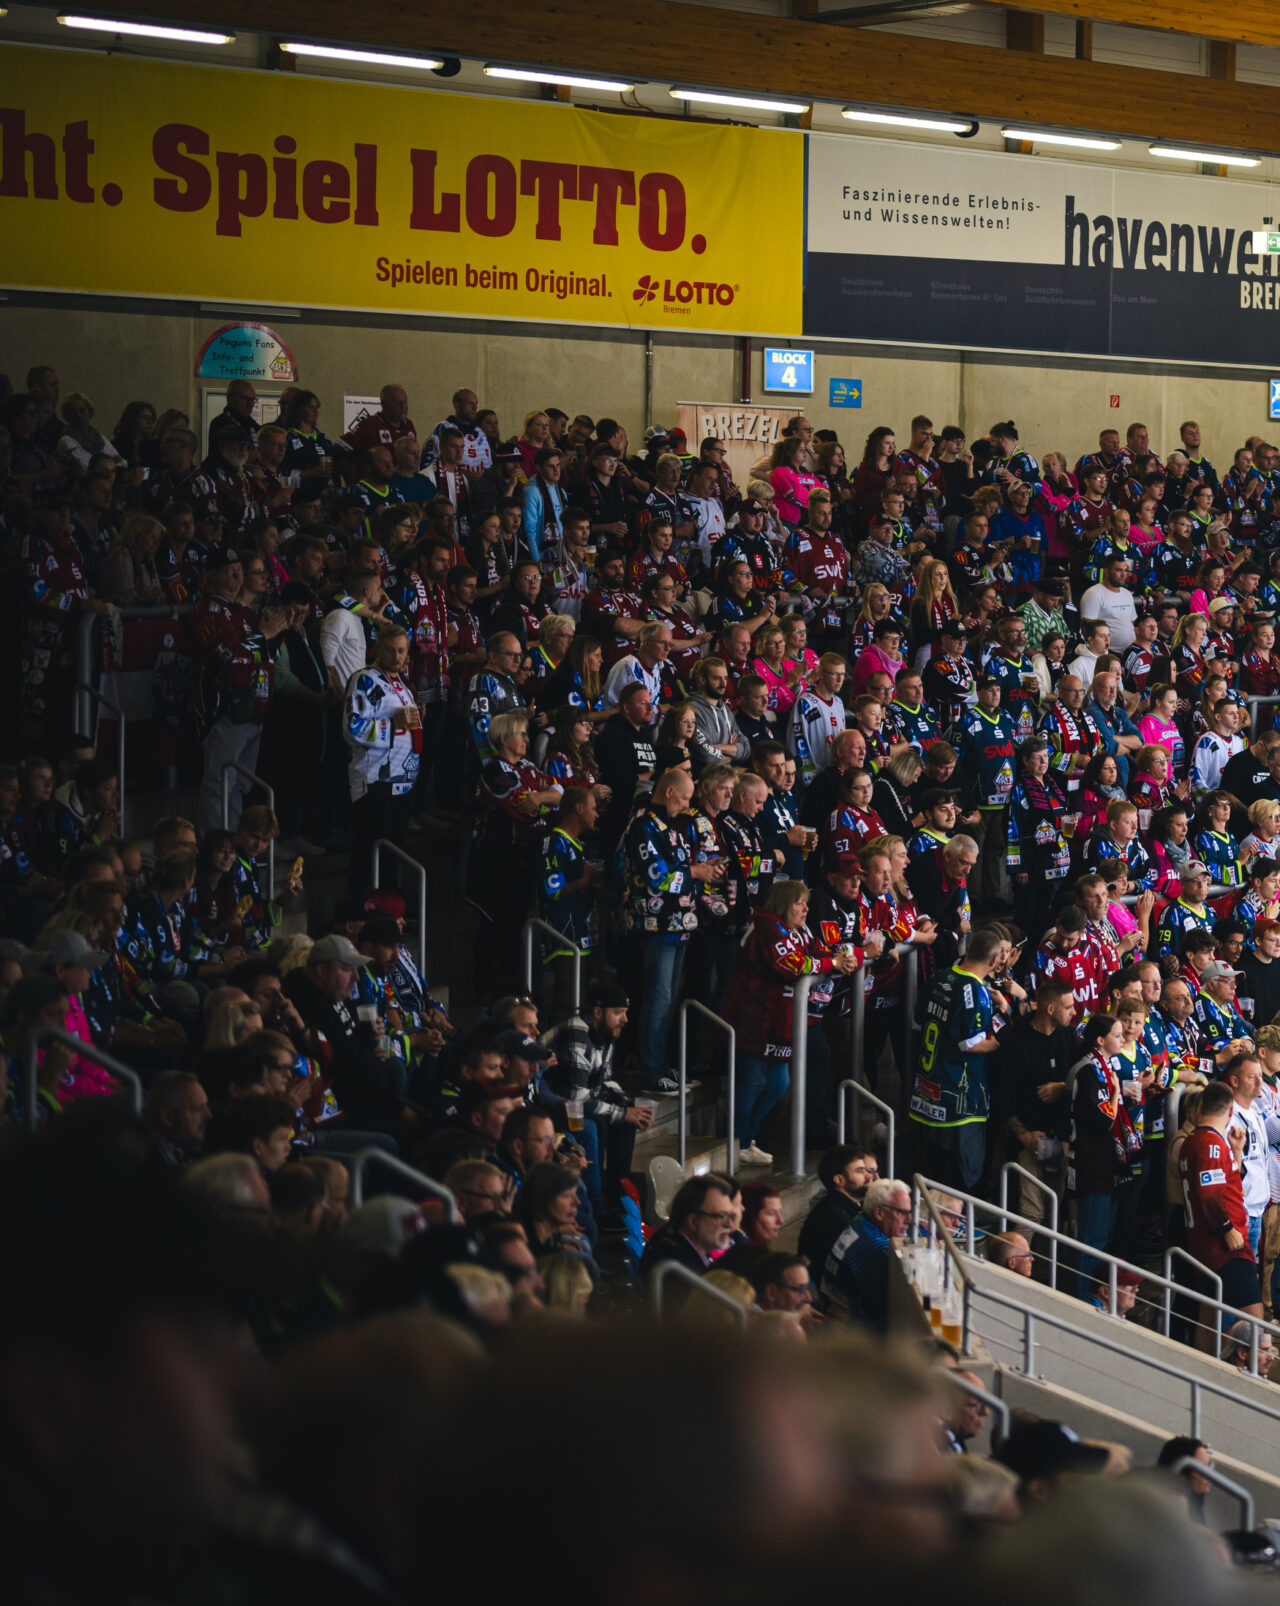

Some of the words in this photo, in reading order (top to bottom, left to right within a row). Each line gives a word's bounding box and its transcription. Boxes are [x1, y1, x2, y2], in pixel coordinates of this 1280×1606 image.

[152, 122, 380, 237] Spiel
[409, 147, 708, 254] LOTTO.
[842, 185, 960, 208] Faszinierende
[968, 194, 1041, 213] Erlebnis-
[842, 207, 874, 224] und
[880, 209, 1012, 231] Wissenswelten!
[375, 255, 459, 291] Spielen
[465, 261, 519, 293] beim
[525, 267, 613, 300] Original.
[663, 304, 691, 315] Bremen
[255, 339, 275, 349] Fans
[212, 352, 235, 361] Info-
[240, 354, 254, 363] und
[771, 352, 807, 366] BLOCK
[220, 366, 266, 377] Treffpunkt
[781, 366, 797, 388] 4
[700, 412, 781, 444] BREZEL
[470, 697, 489, 713] 43
[835, 838, 849, 853] 57
[544, 855, 558, 870] 14
[1159, 929, 1172, 942] 79
[775, 939, 796, 956] 64
[1209, 1024, 1219, 1037] 9
[922, 1021, 939, 1073] 9
[1209, 1144, 1220, 1159] 16
